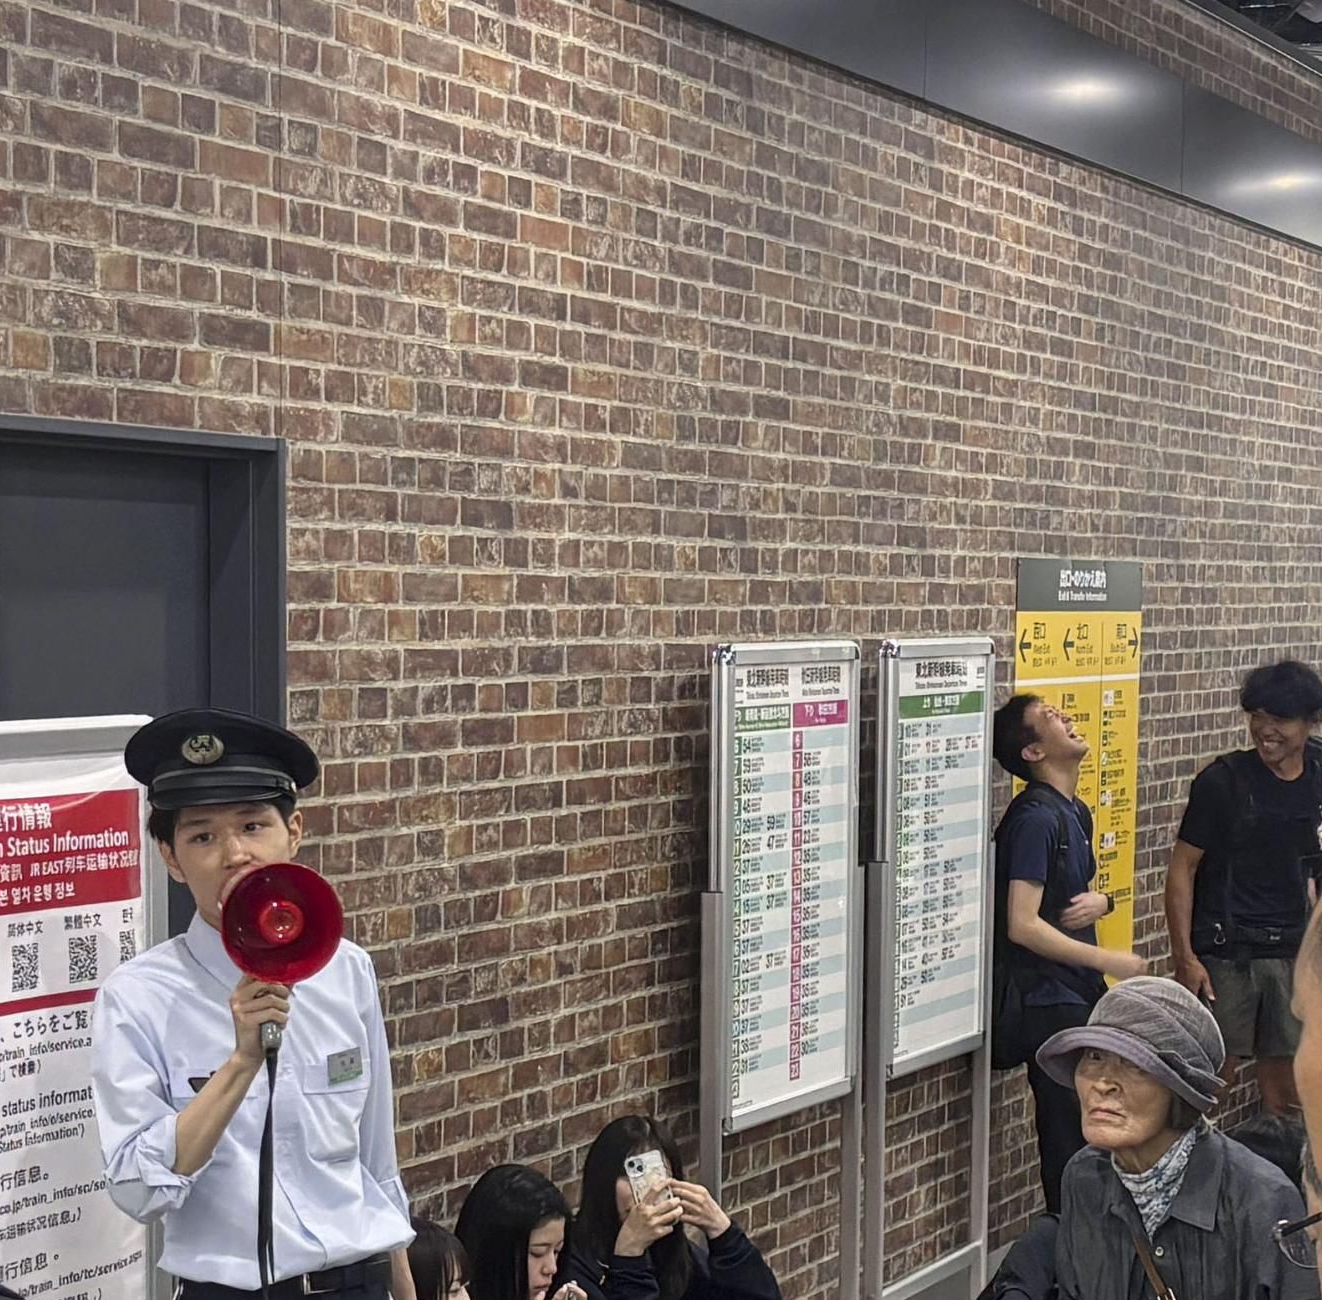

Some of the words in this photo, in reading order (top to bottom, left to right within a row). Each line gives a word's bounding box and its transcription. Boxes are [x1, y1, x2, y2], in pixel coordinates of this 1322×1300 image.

[7, 835, 50, 857] Status
[53, 827, 130, 853] Information
[2, 1098, 37, 1118] status
